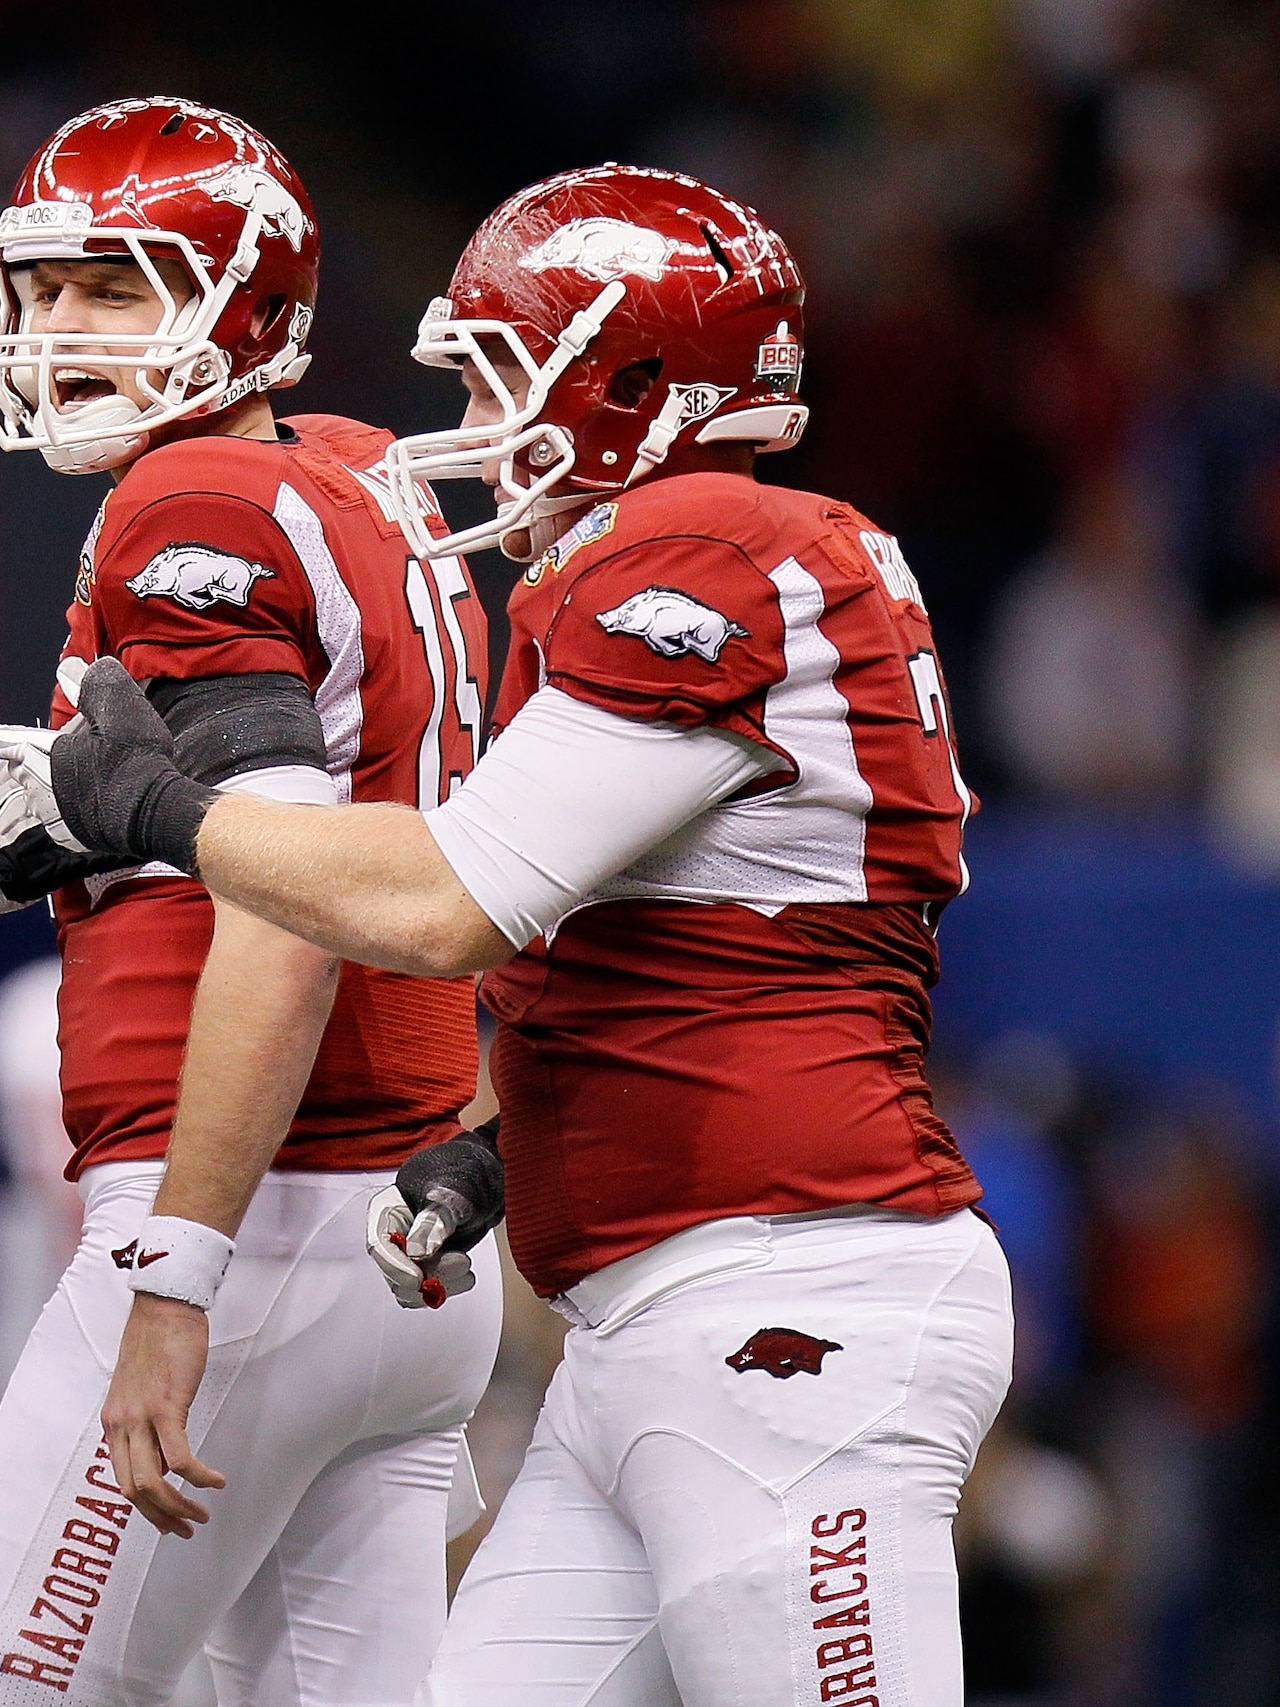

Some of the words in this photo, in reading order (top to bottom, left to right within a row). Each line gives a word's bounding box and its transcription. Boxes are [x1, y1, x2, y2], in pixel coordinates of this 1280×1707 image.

[763, 348, 796, 366] BCS
[685, 389, 708, 416] SEC
[404, 556, 482, 812] 15
